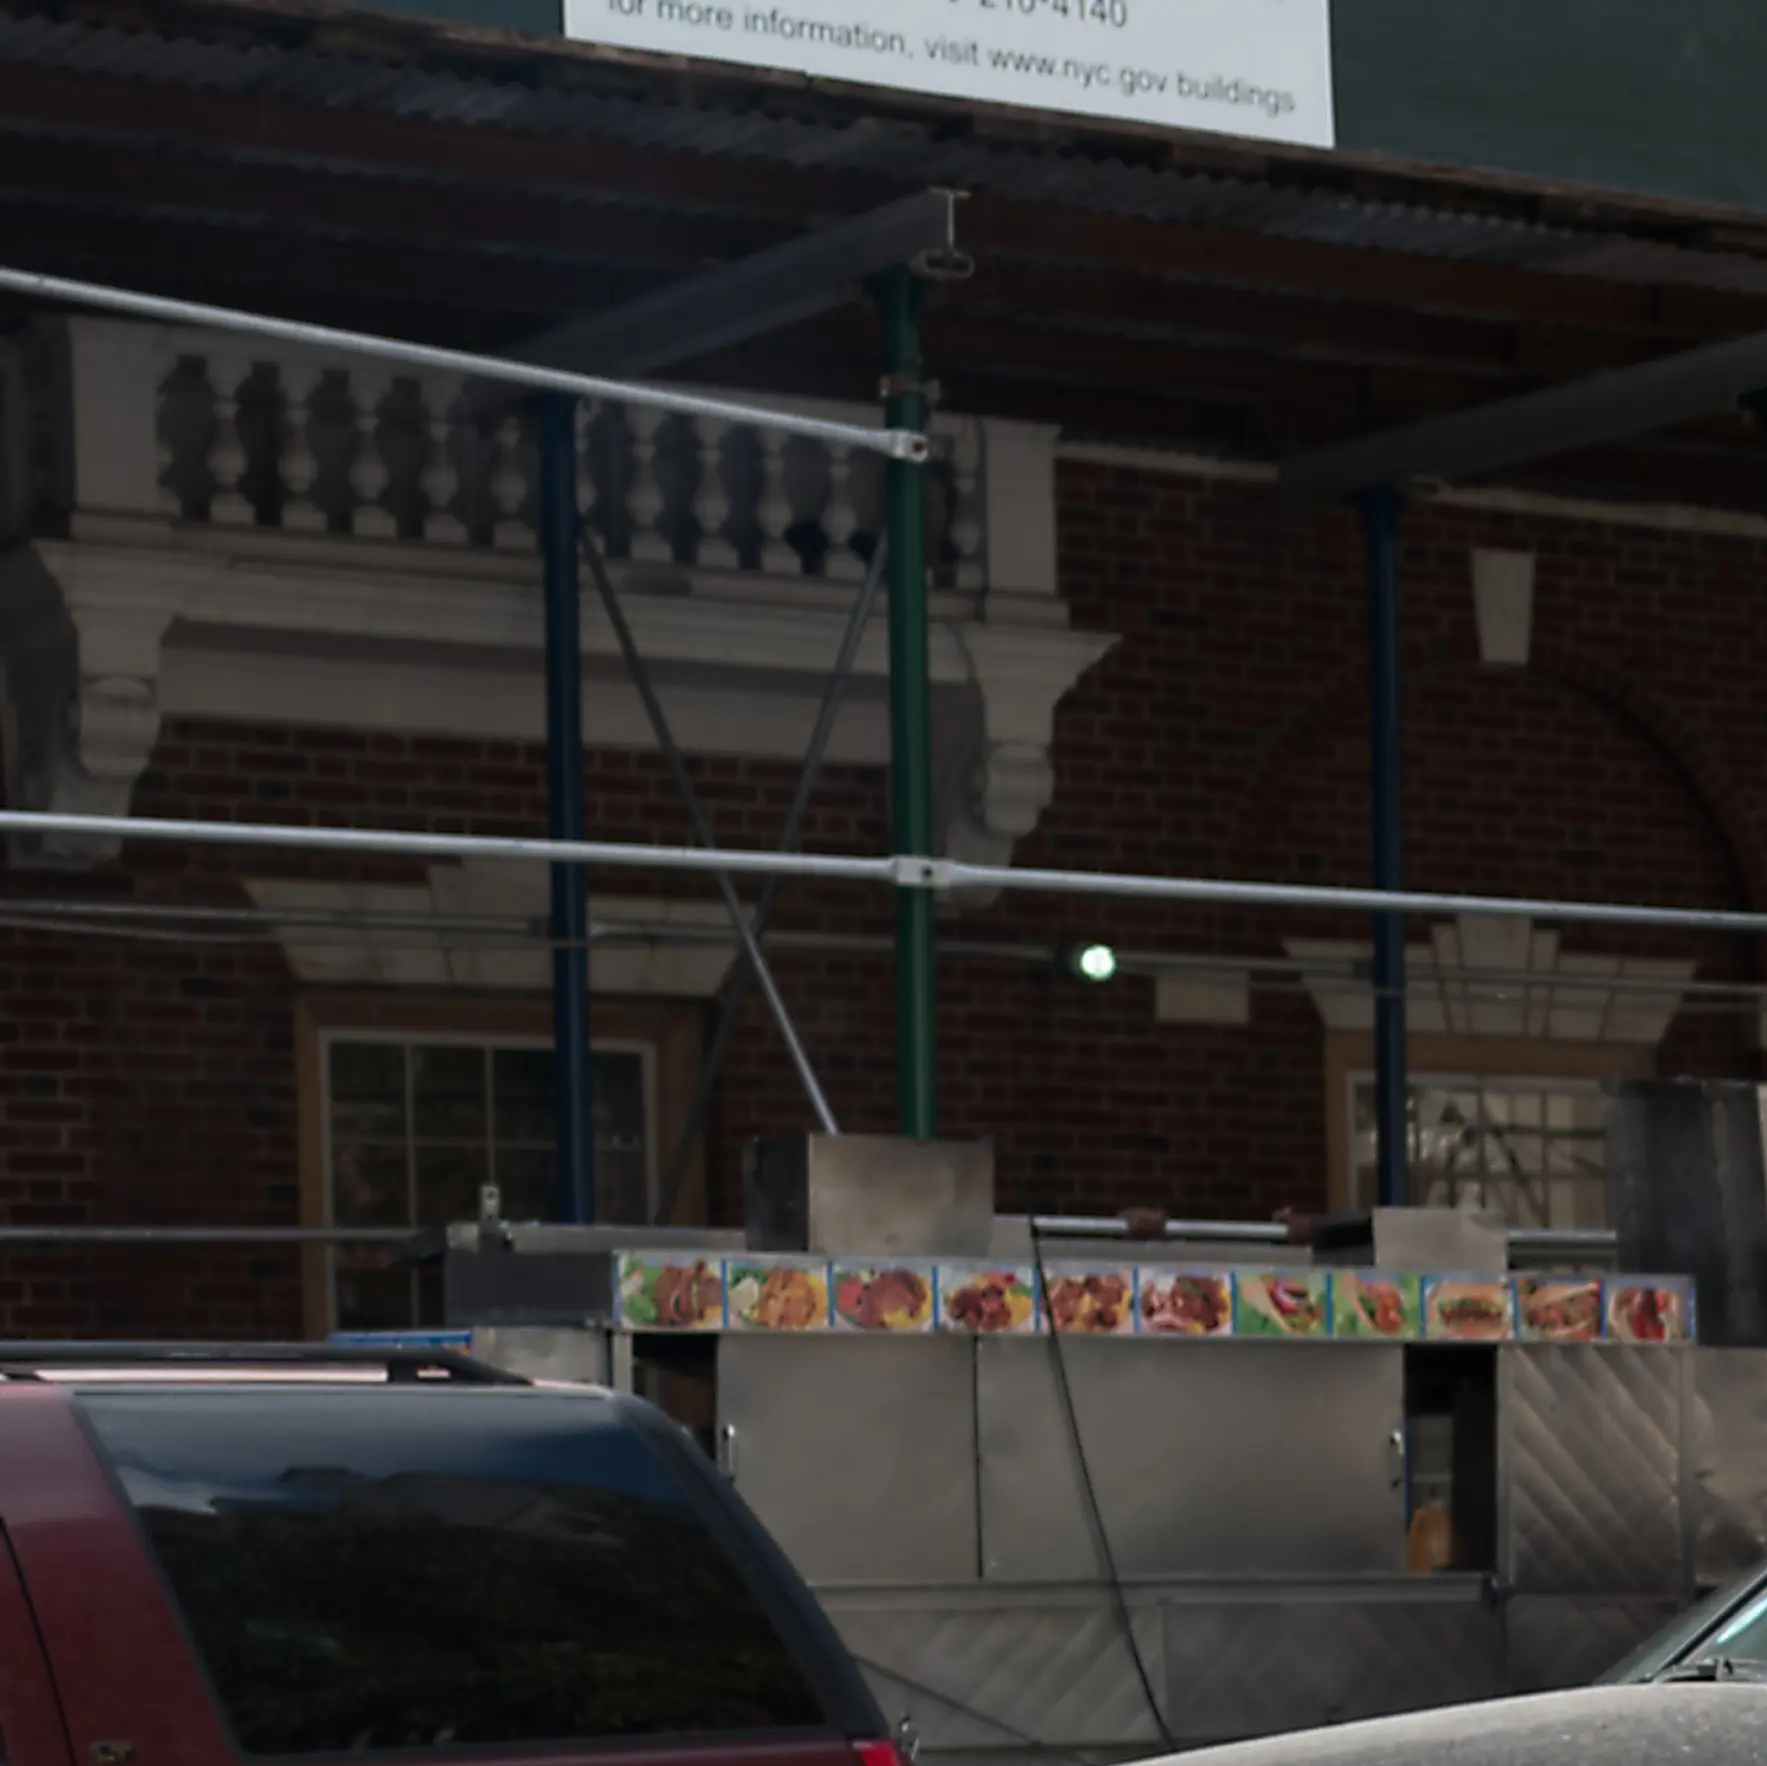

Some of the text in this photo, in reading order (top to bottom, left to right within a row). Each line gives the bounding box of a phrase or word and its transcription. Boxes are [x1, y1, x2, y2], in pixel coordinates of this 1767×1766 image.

[657, 0, 733, 30] more
[744, 9, 914, 59] information,
[924, 37, 980, 66] visit
